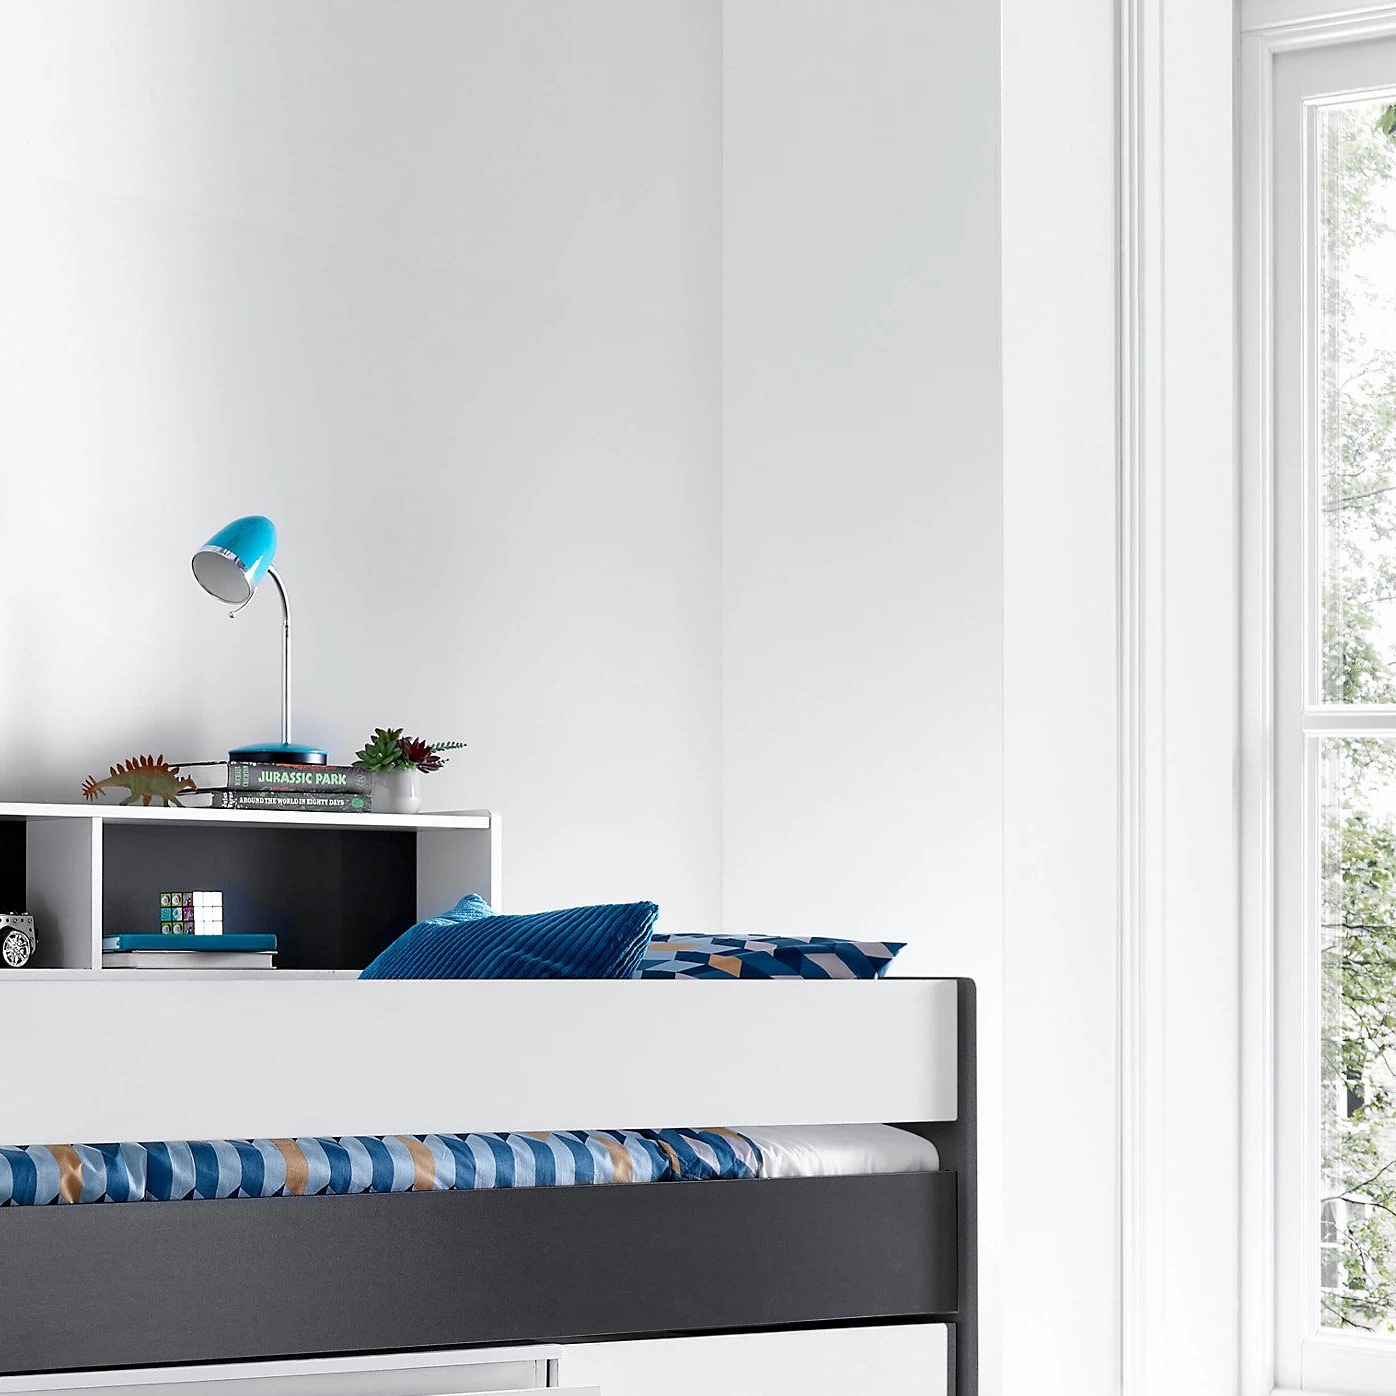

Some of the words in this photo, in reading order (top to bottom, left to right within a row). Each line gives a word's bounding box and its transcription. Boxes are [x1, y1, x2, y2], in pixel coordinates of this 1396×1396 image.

[258, 771, 313, 784] JURASSIC
[315, 773, 347, 785] PARK
[264, 797, 277, 805] THE
[277, 797, 299, 805] WORLD
[307, 798, 329, 806] EIGHTY
